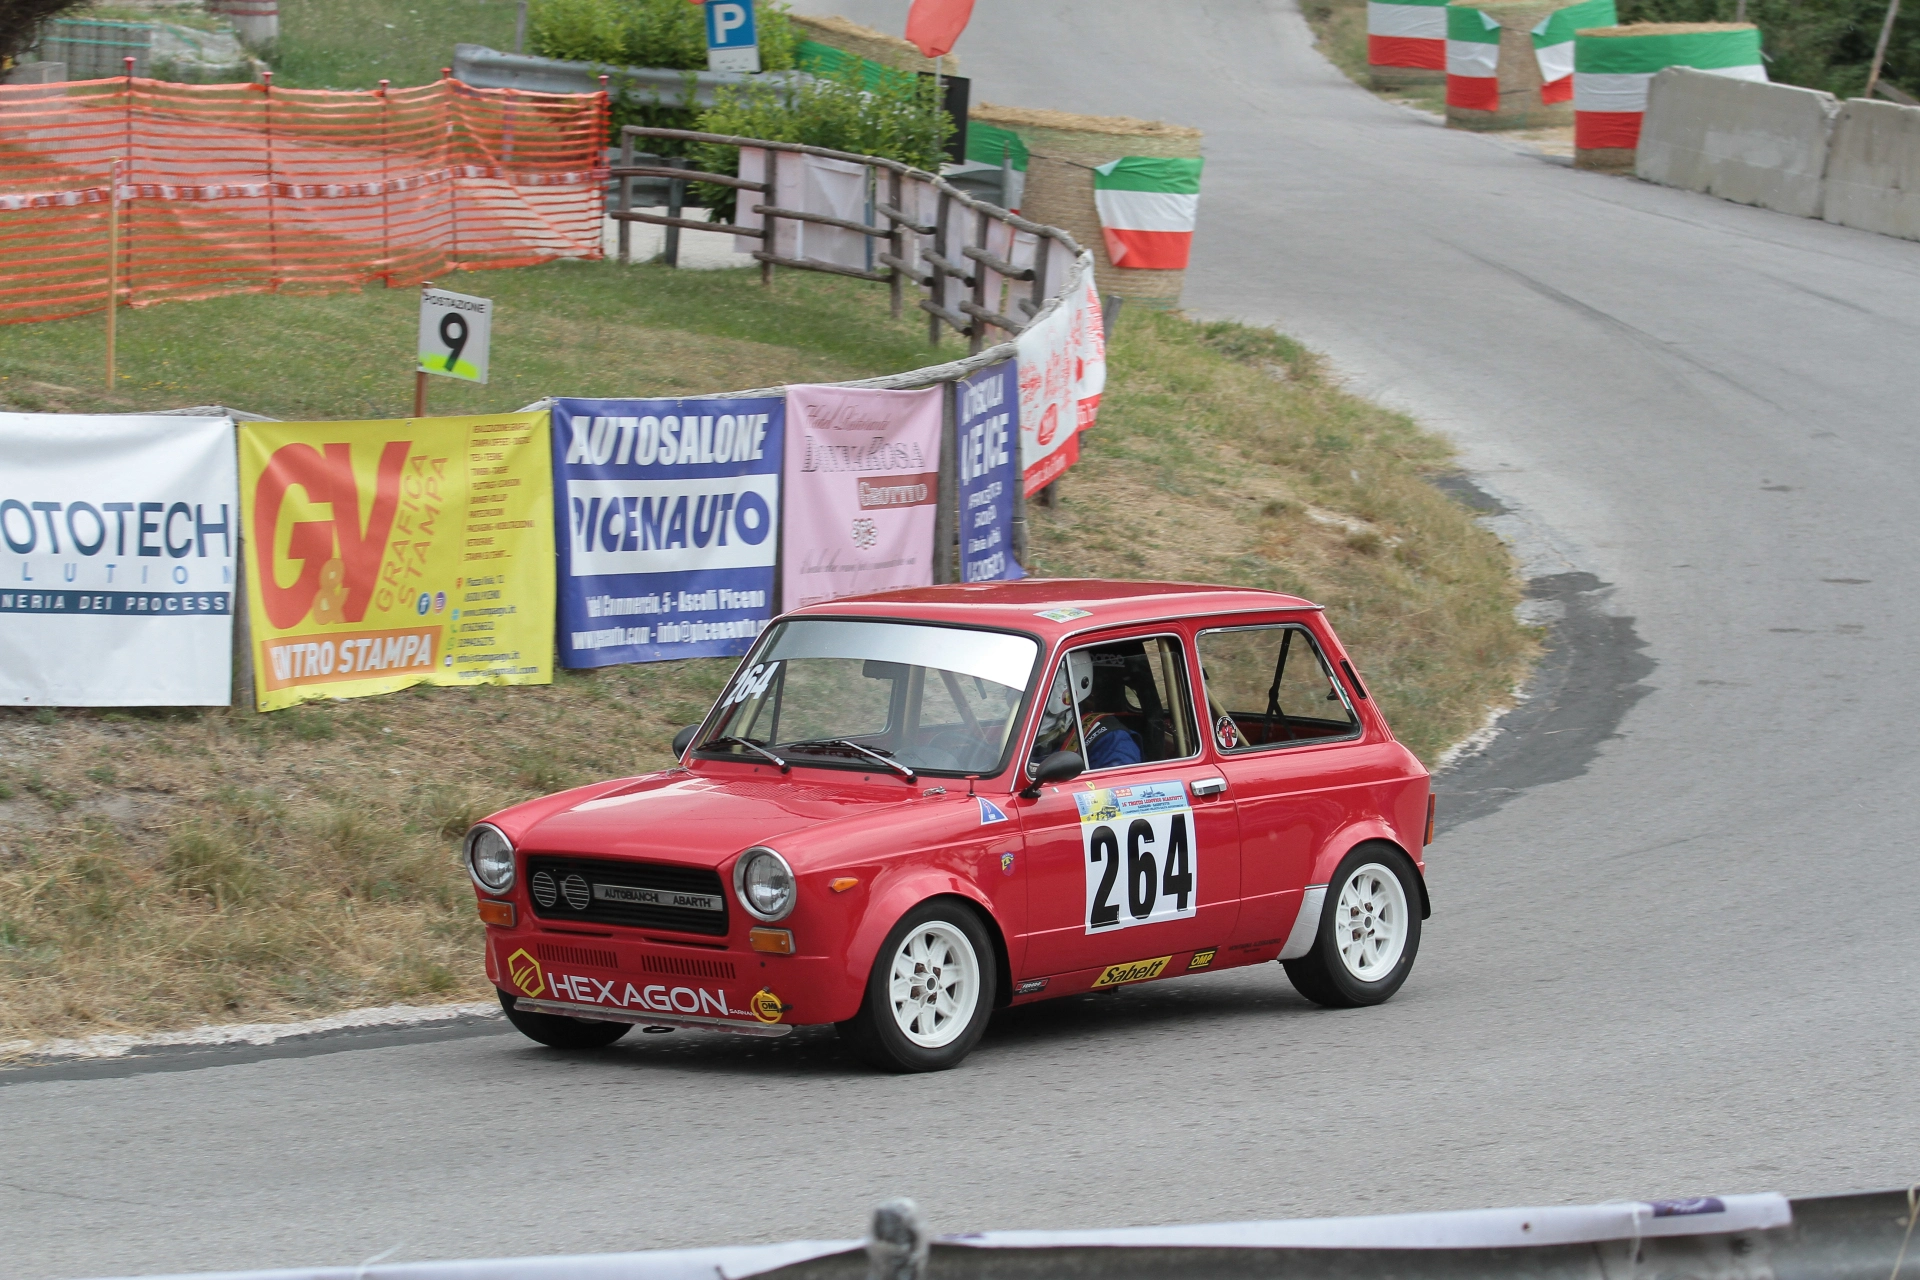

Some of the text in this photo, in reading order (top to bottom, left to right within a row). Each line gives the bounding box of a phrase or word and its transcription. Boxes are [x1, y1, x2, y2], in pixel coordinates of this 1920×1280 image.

[713, 3, 746, 44] P
[440, 312, 468, 372] 9
[566, 414, 769, 465] AUTOSALONE
[0, 499, 231, 558] OTOTECH
[375, 454, 430, 613] GRAFICA
[398, 456, 448, 608] STAMPA
[572, 491, 770, 552] PICENAUTO
[79, 596, 112, 610] DEI
[719, 588, 765, 609] Piceno
[337, 634, 432, 673] STAMPA
[720, 661, 780, 709] 264
[1090, 813, 1193, 929] 264
[605, 888, 711, 908] AUTOBIANCHI ABARTH
[1101, 959, 1164, 985] Sabelt
[1191, 952, 1213, 967] OMP
[547, 972, 728, 1016] HEXAGON
